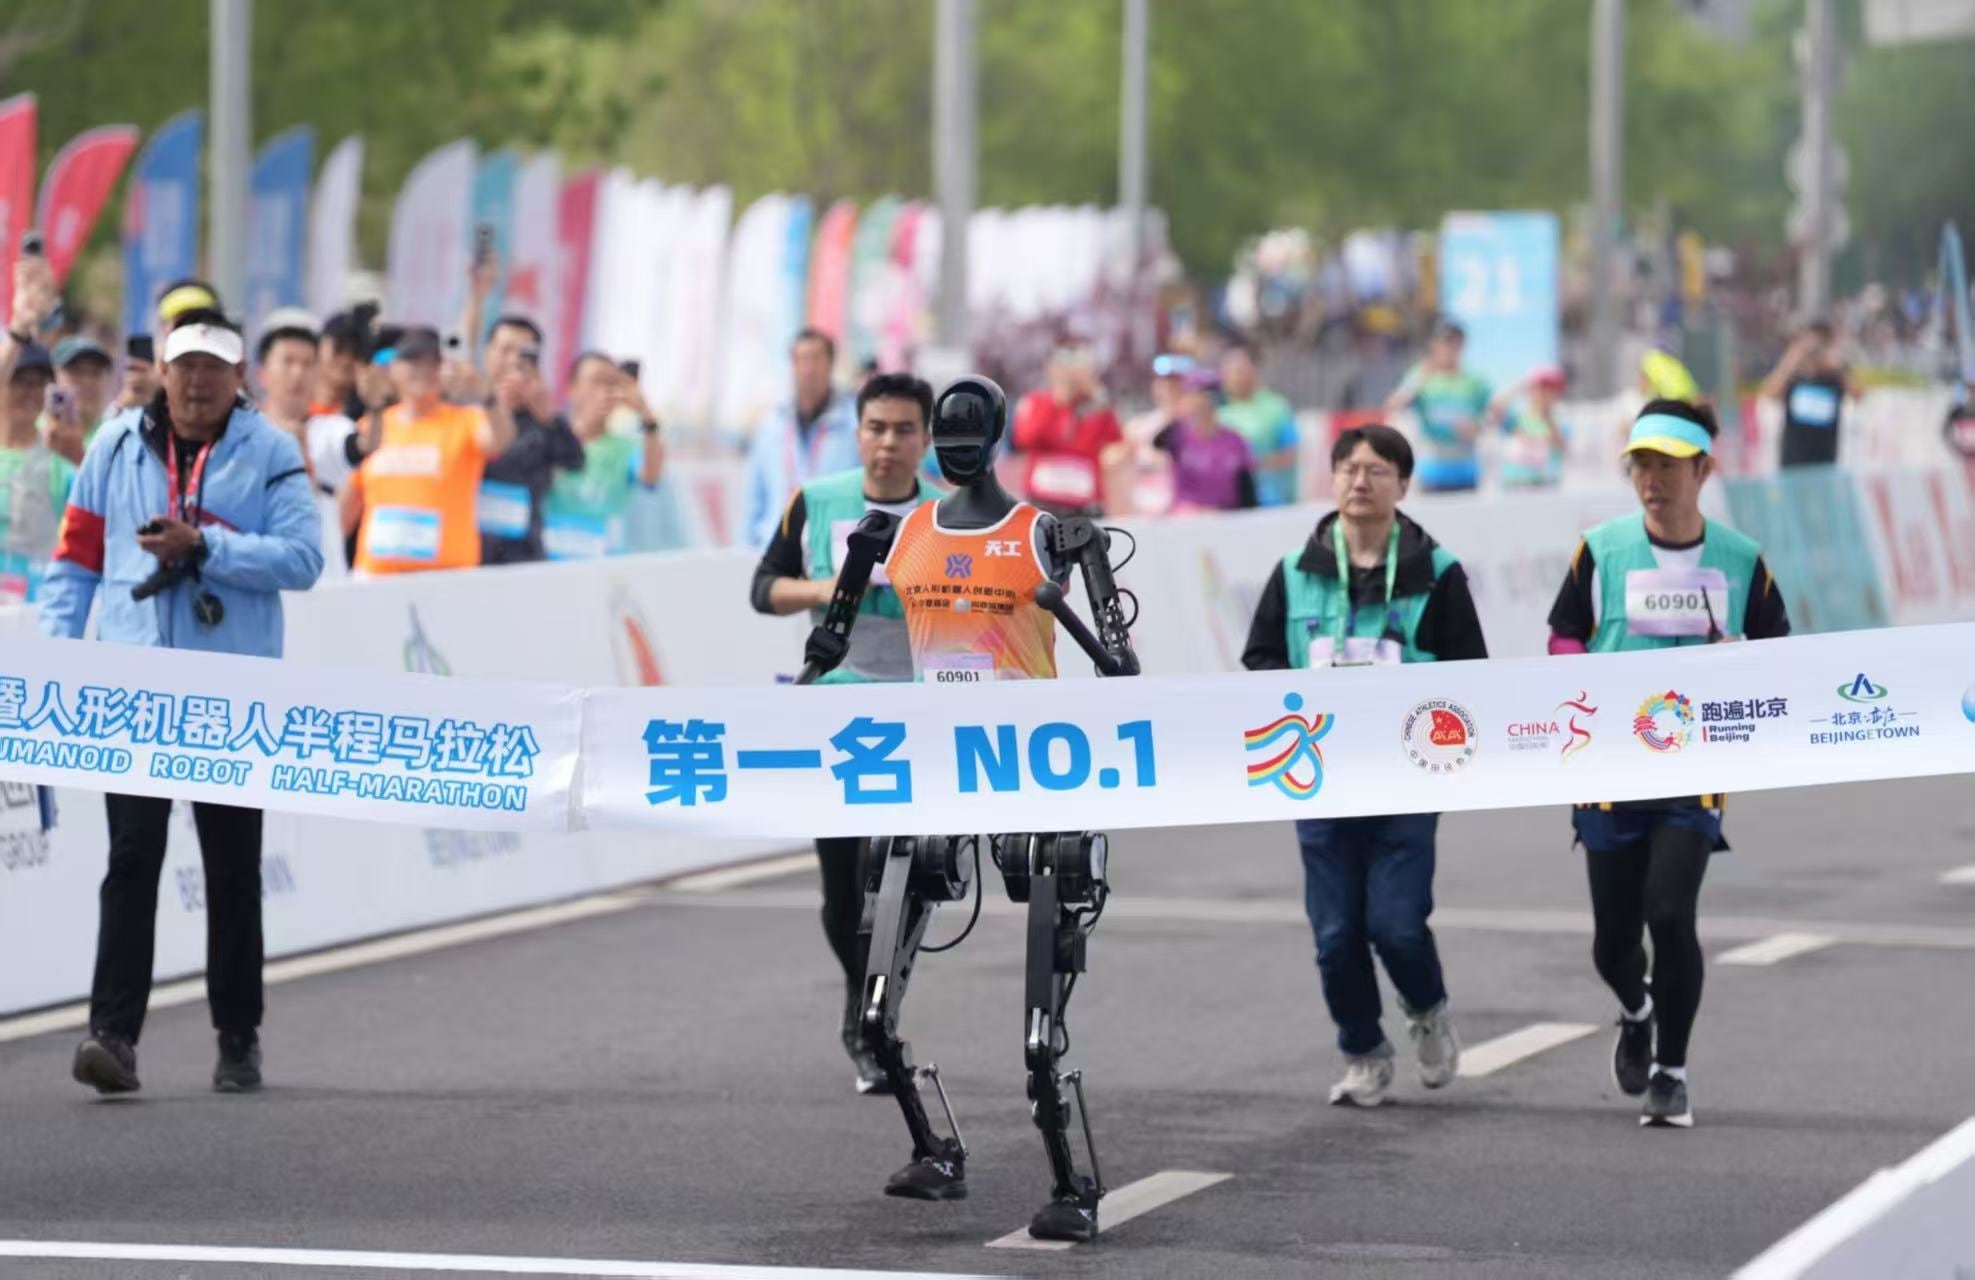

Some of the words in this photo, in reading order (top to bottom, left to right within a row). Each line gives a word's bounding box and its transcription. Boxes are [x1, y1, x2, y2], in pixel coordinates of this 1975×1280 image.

[937, 671, 980, 682] 60901
[1415, 701, 1447, 715] ATHLETICS
[1702, 697, 1788, 722] 跑遍北京
[1508, 721, 1560, 736] CHINA
[1709, 723, 1755, 733] Running
[1710, 732, 1750, 743] Beijing
[642, 717, 912, 806] 第一名
[954, 720, 1156, 793] NO.1
[150, 752, 252, 786] ROBOT
[272, 765, 527, 811] HALF-MARATHON
